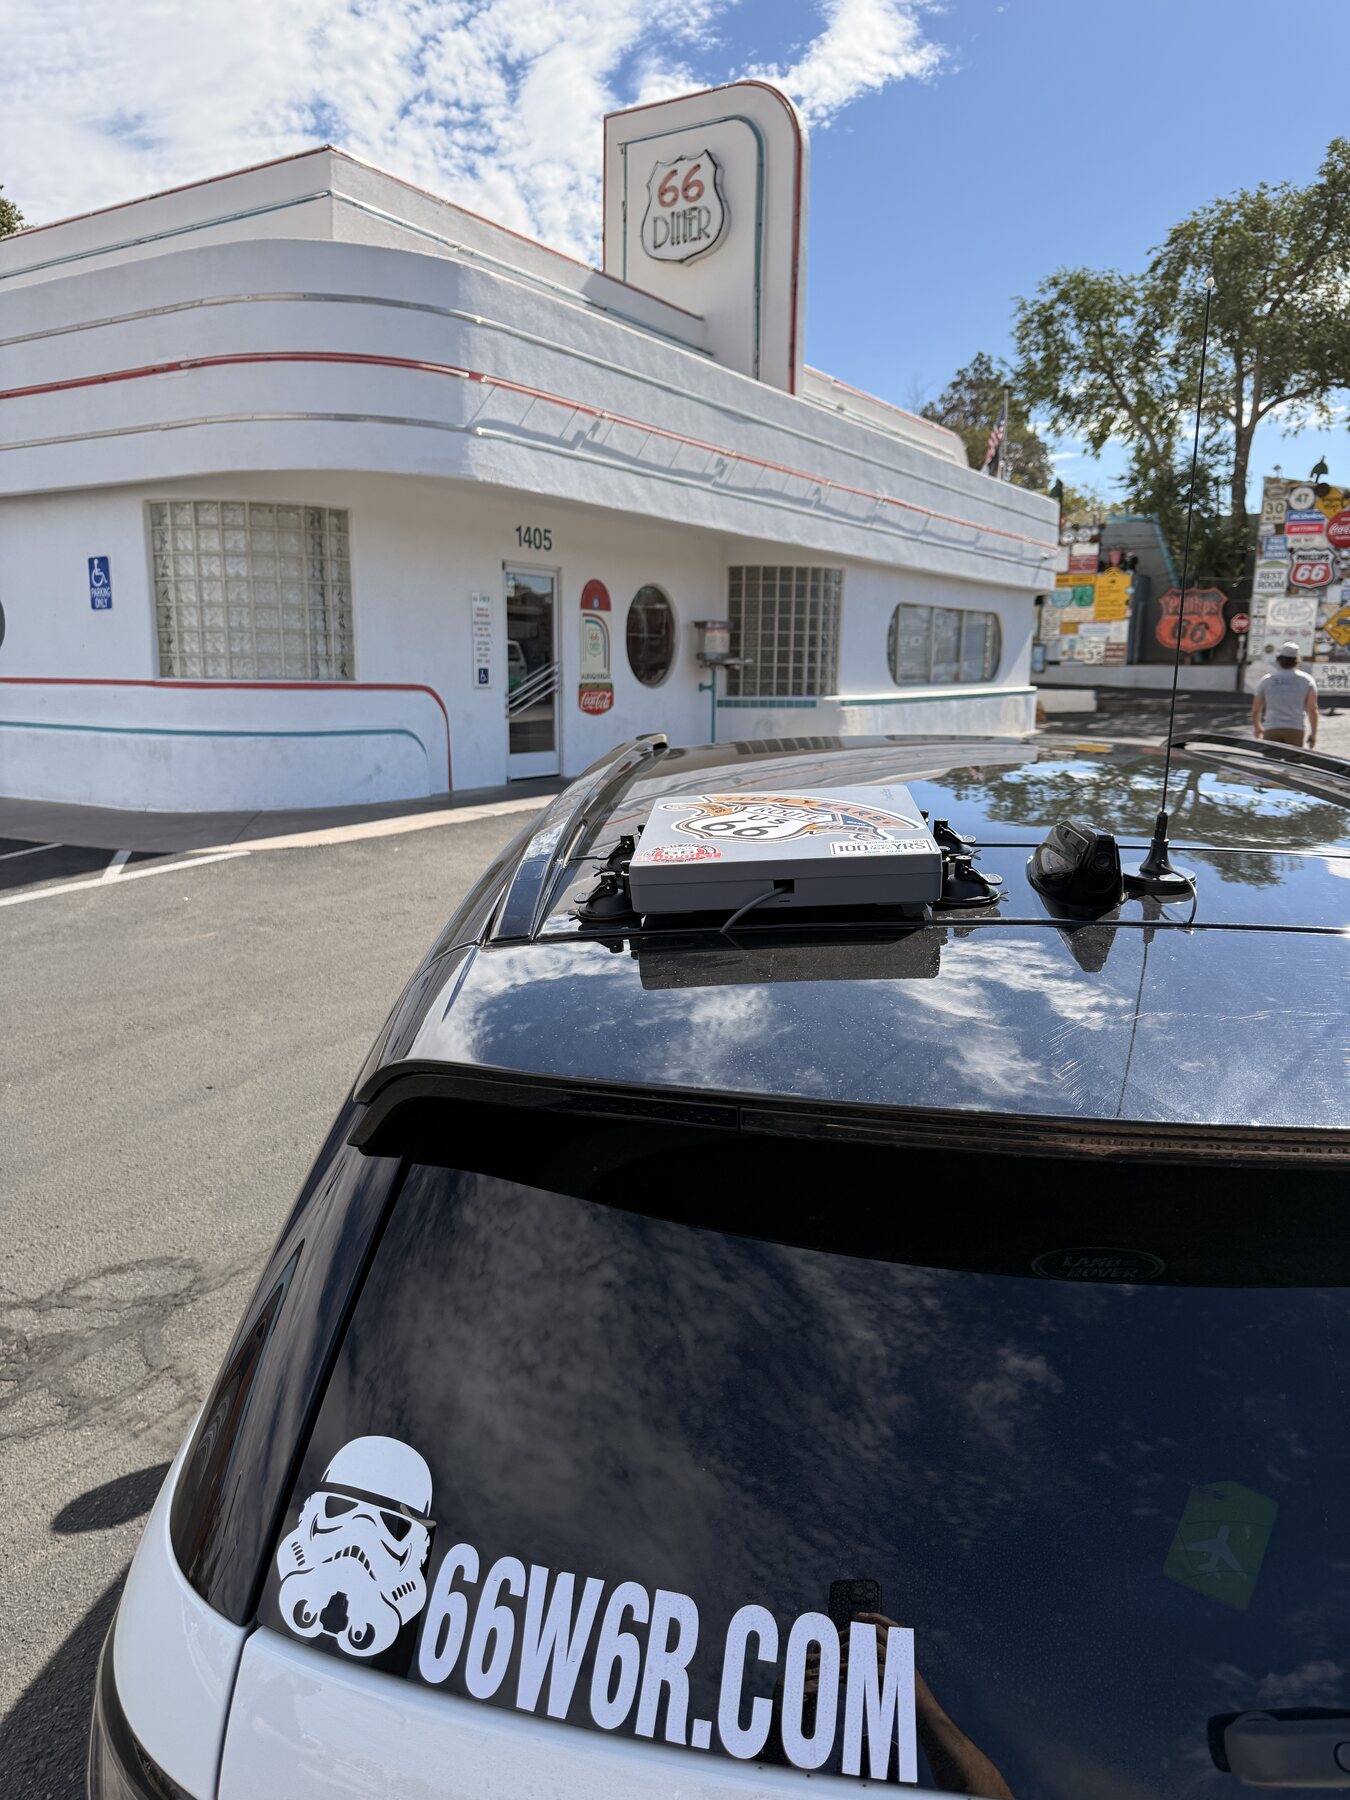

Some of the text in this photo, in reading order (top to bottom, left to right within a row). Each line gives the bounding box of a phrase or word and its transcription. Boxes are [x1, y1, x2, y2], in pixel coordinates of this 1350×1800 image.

[657, 163, 705, 208] 66
[652, 205, 713, 250] DINER
[515, 525, 553, 551] 1405
[1296, 564, 1328, 581] 66
[1171, 619, 1209, 643] 66
[581, 690, 612, 710] Coca-Cola
[747, 814, 790, 825] US
[753, 806, 827, 823] ROUTE
[701, 820, 779, 837] 66
[836, 844, 868, 852] 100
[891, 842, 927, 850] YRS
[1062, 1255, 1124, 1267] LAND
[1066, 1267, 1139, 1279] ROVER
[418, 1543, 918, 1783] 66W6R.COM
